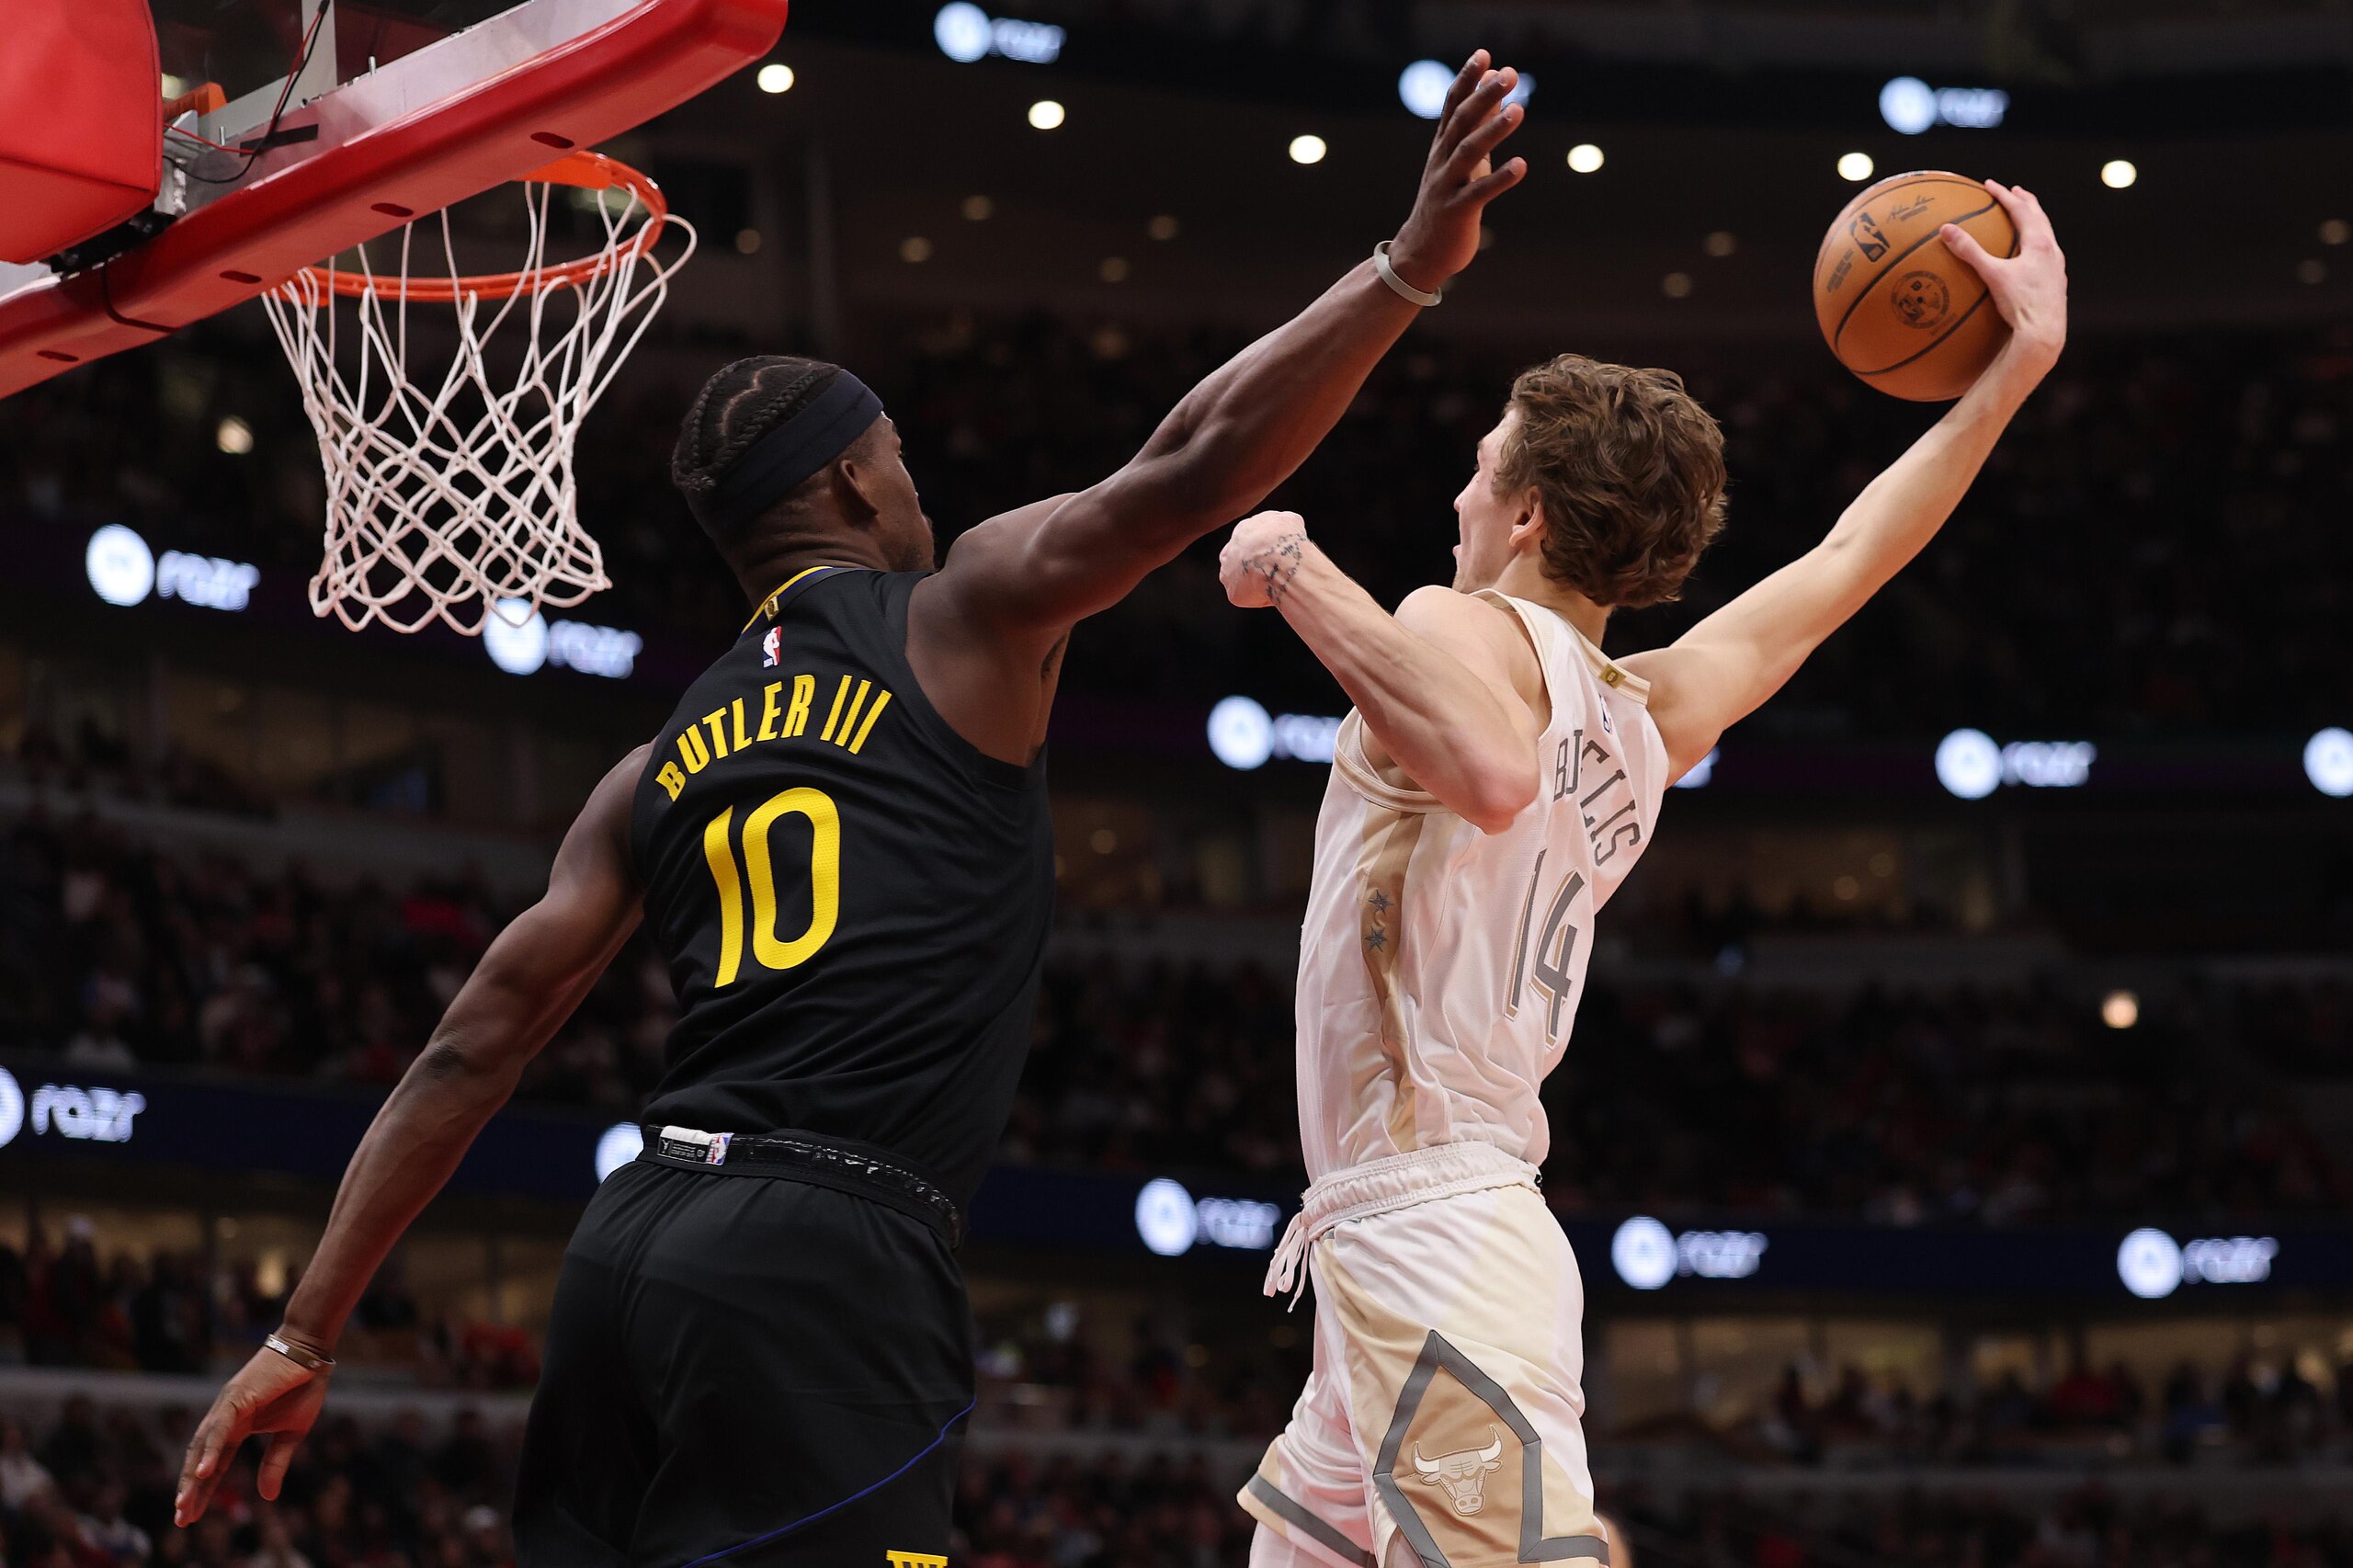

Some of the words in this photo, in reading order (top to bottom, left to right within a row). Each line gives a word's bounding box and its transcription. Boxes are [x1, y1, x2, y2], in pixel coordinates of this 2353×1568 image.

[654, 674, 816, 802] BUTLER
[820, 675, 892, 755] III
[703, 787, 840, 988] 10
[1504, 848, 1586, 1051] 14
